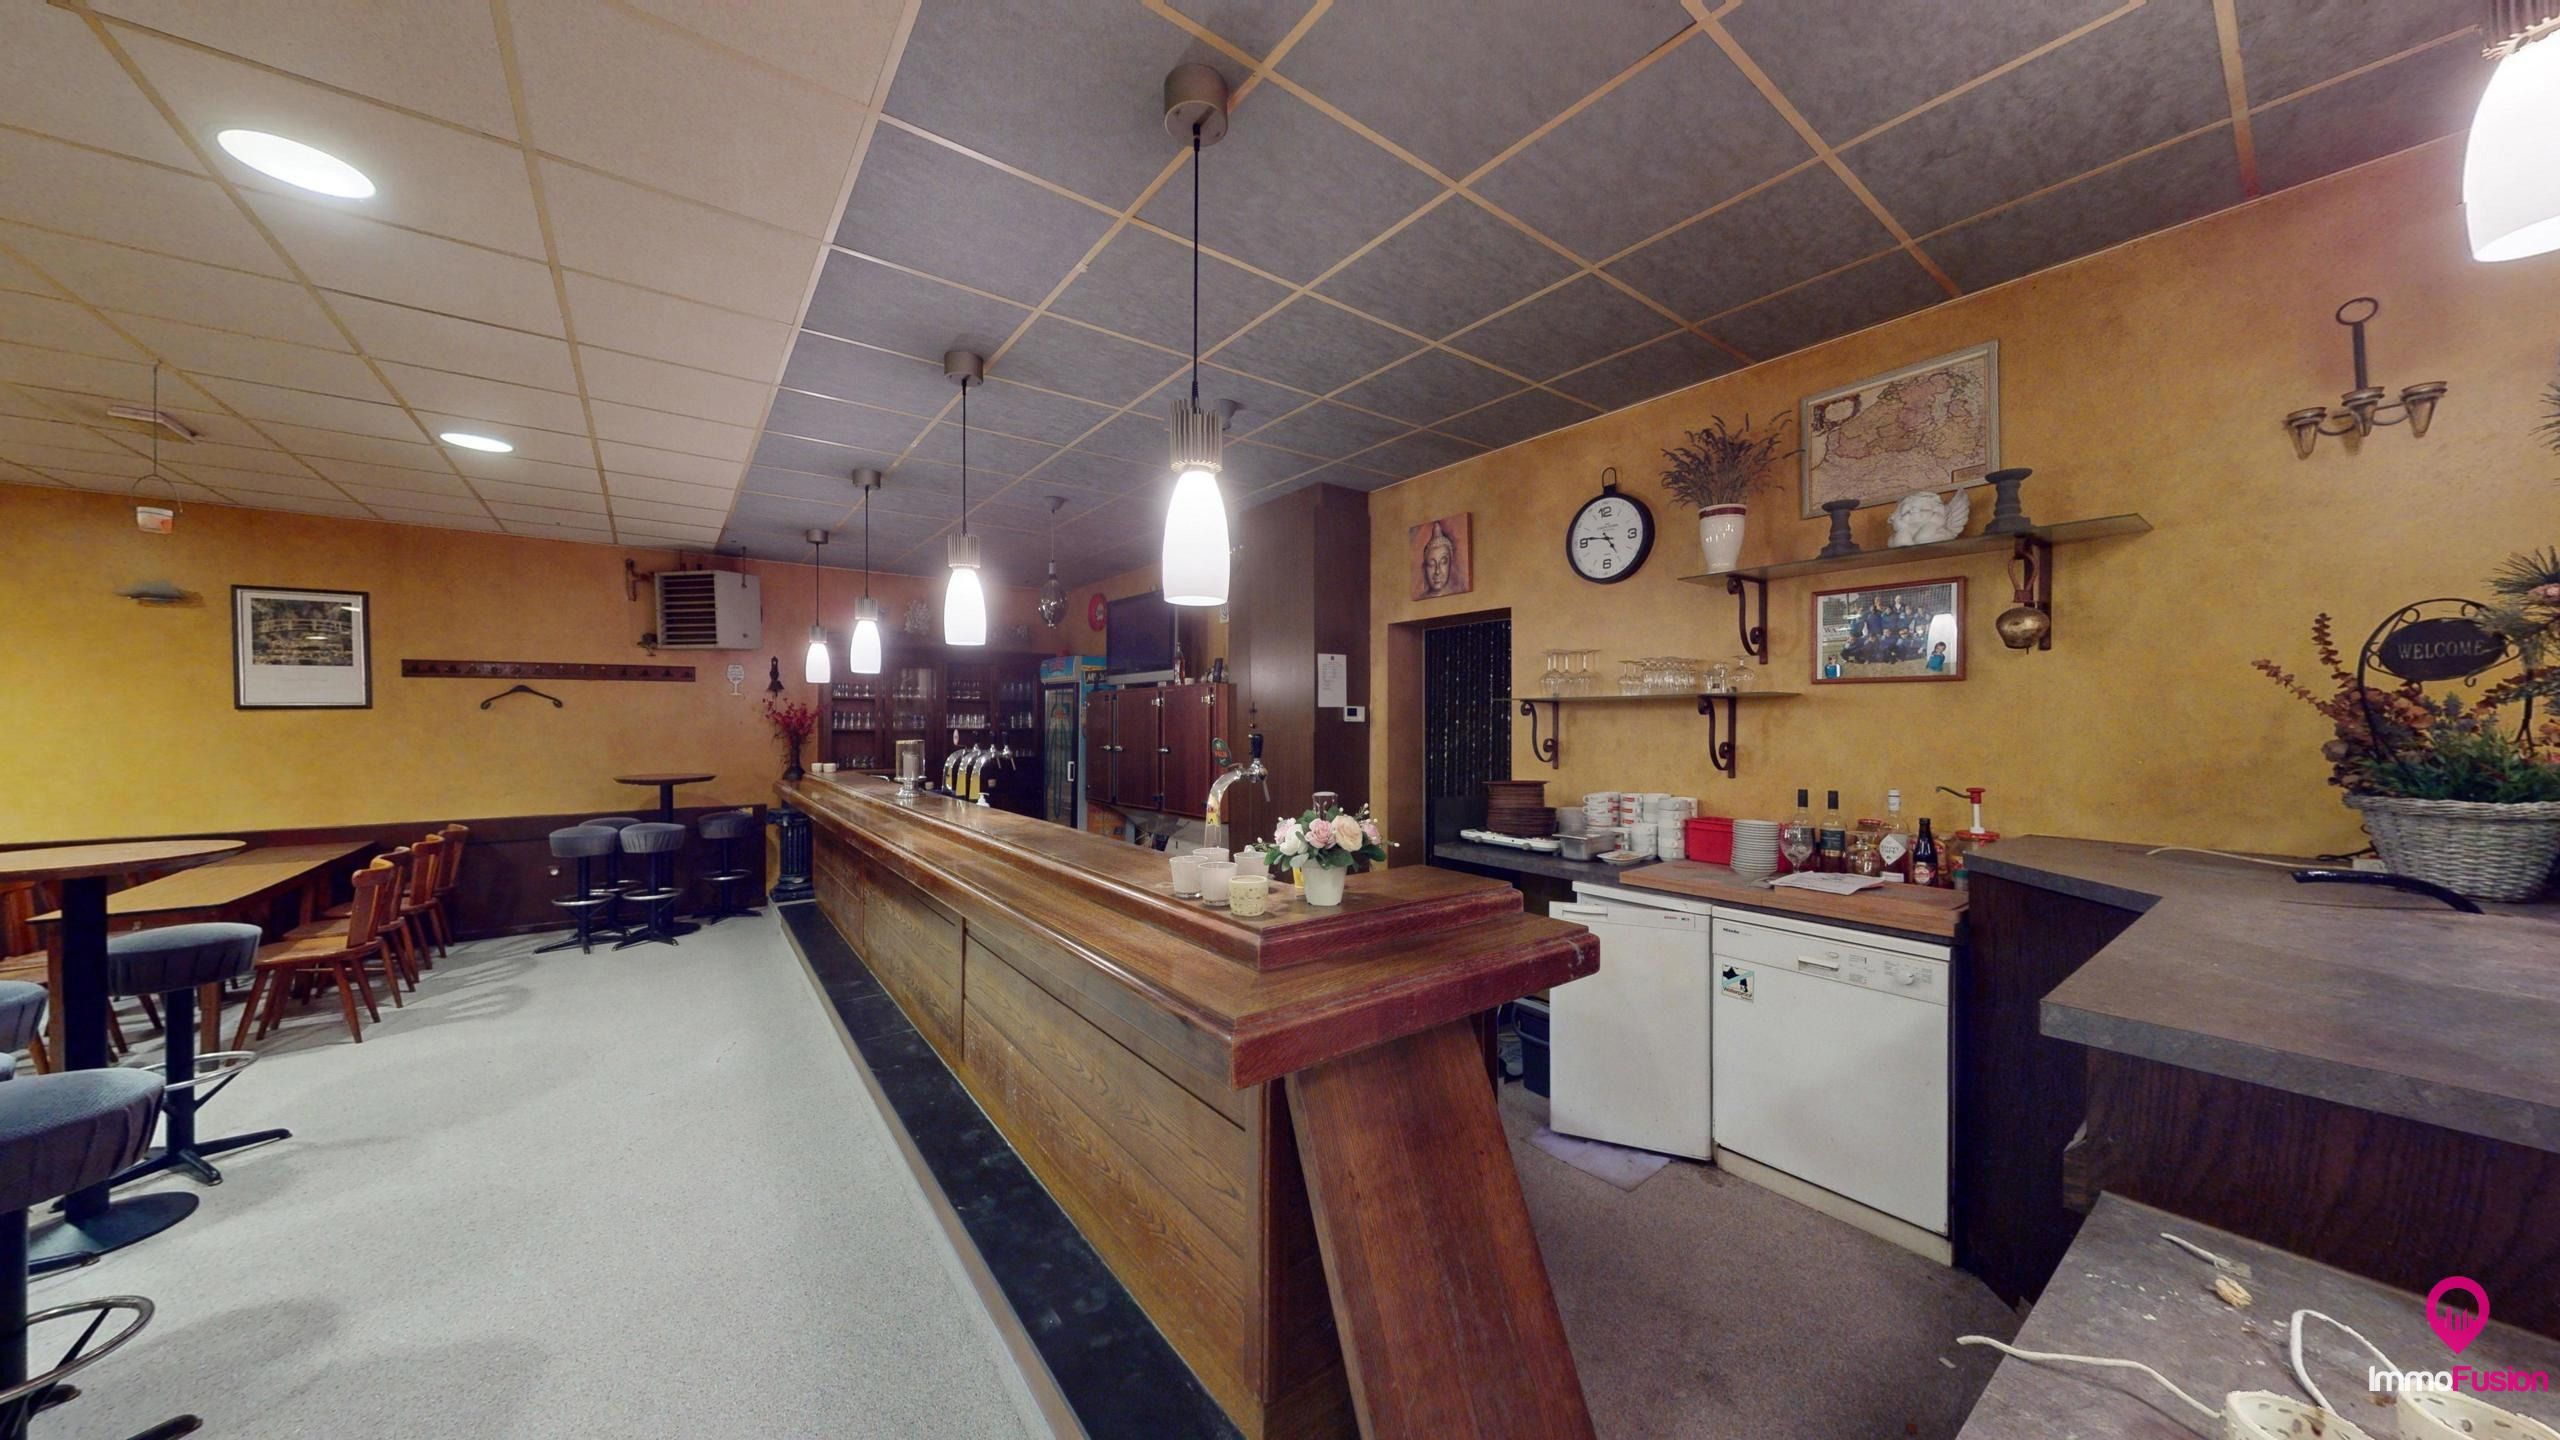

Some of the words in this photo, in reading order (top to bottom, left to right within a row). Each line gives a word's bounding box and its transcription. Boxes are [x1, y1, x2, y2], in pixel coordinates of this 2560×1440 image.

[1598, 506, 1613, 518] 12
[1627, 527, 1637, 539] 3
[1579, 537, 1588, 549] 9
[1602, 558, 1611, 570] 6
[2397, 640, 2485, 660] WELCOME
